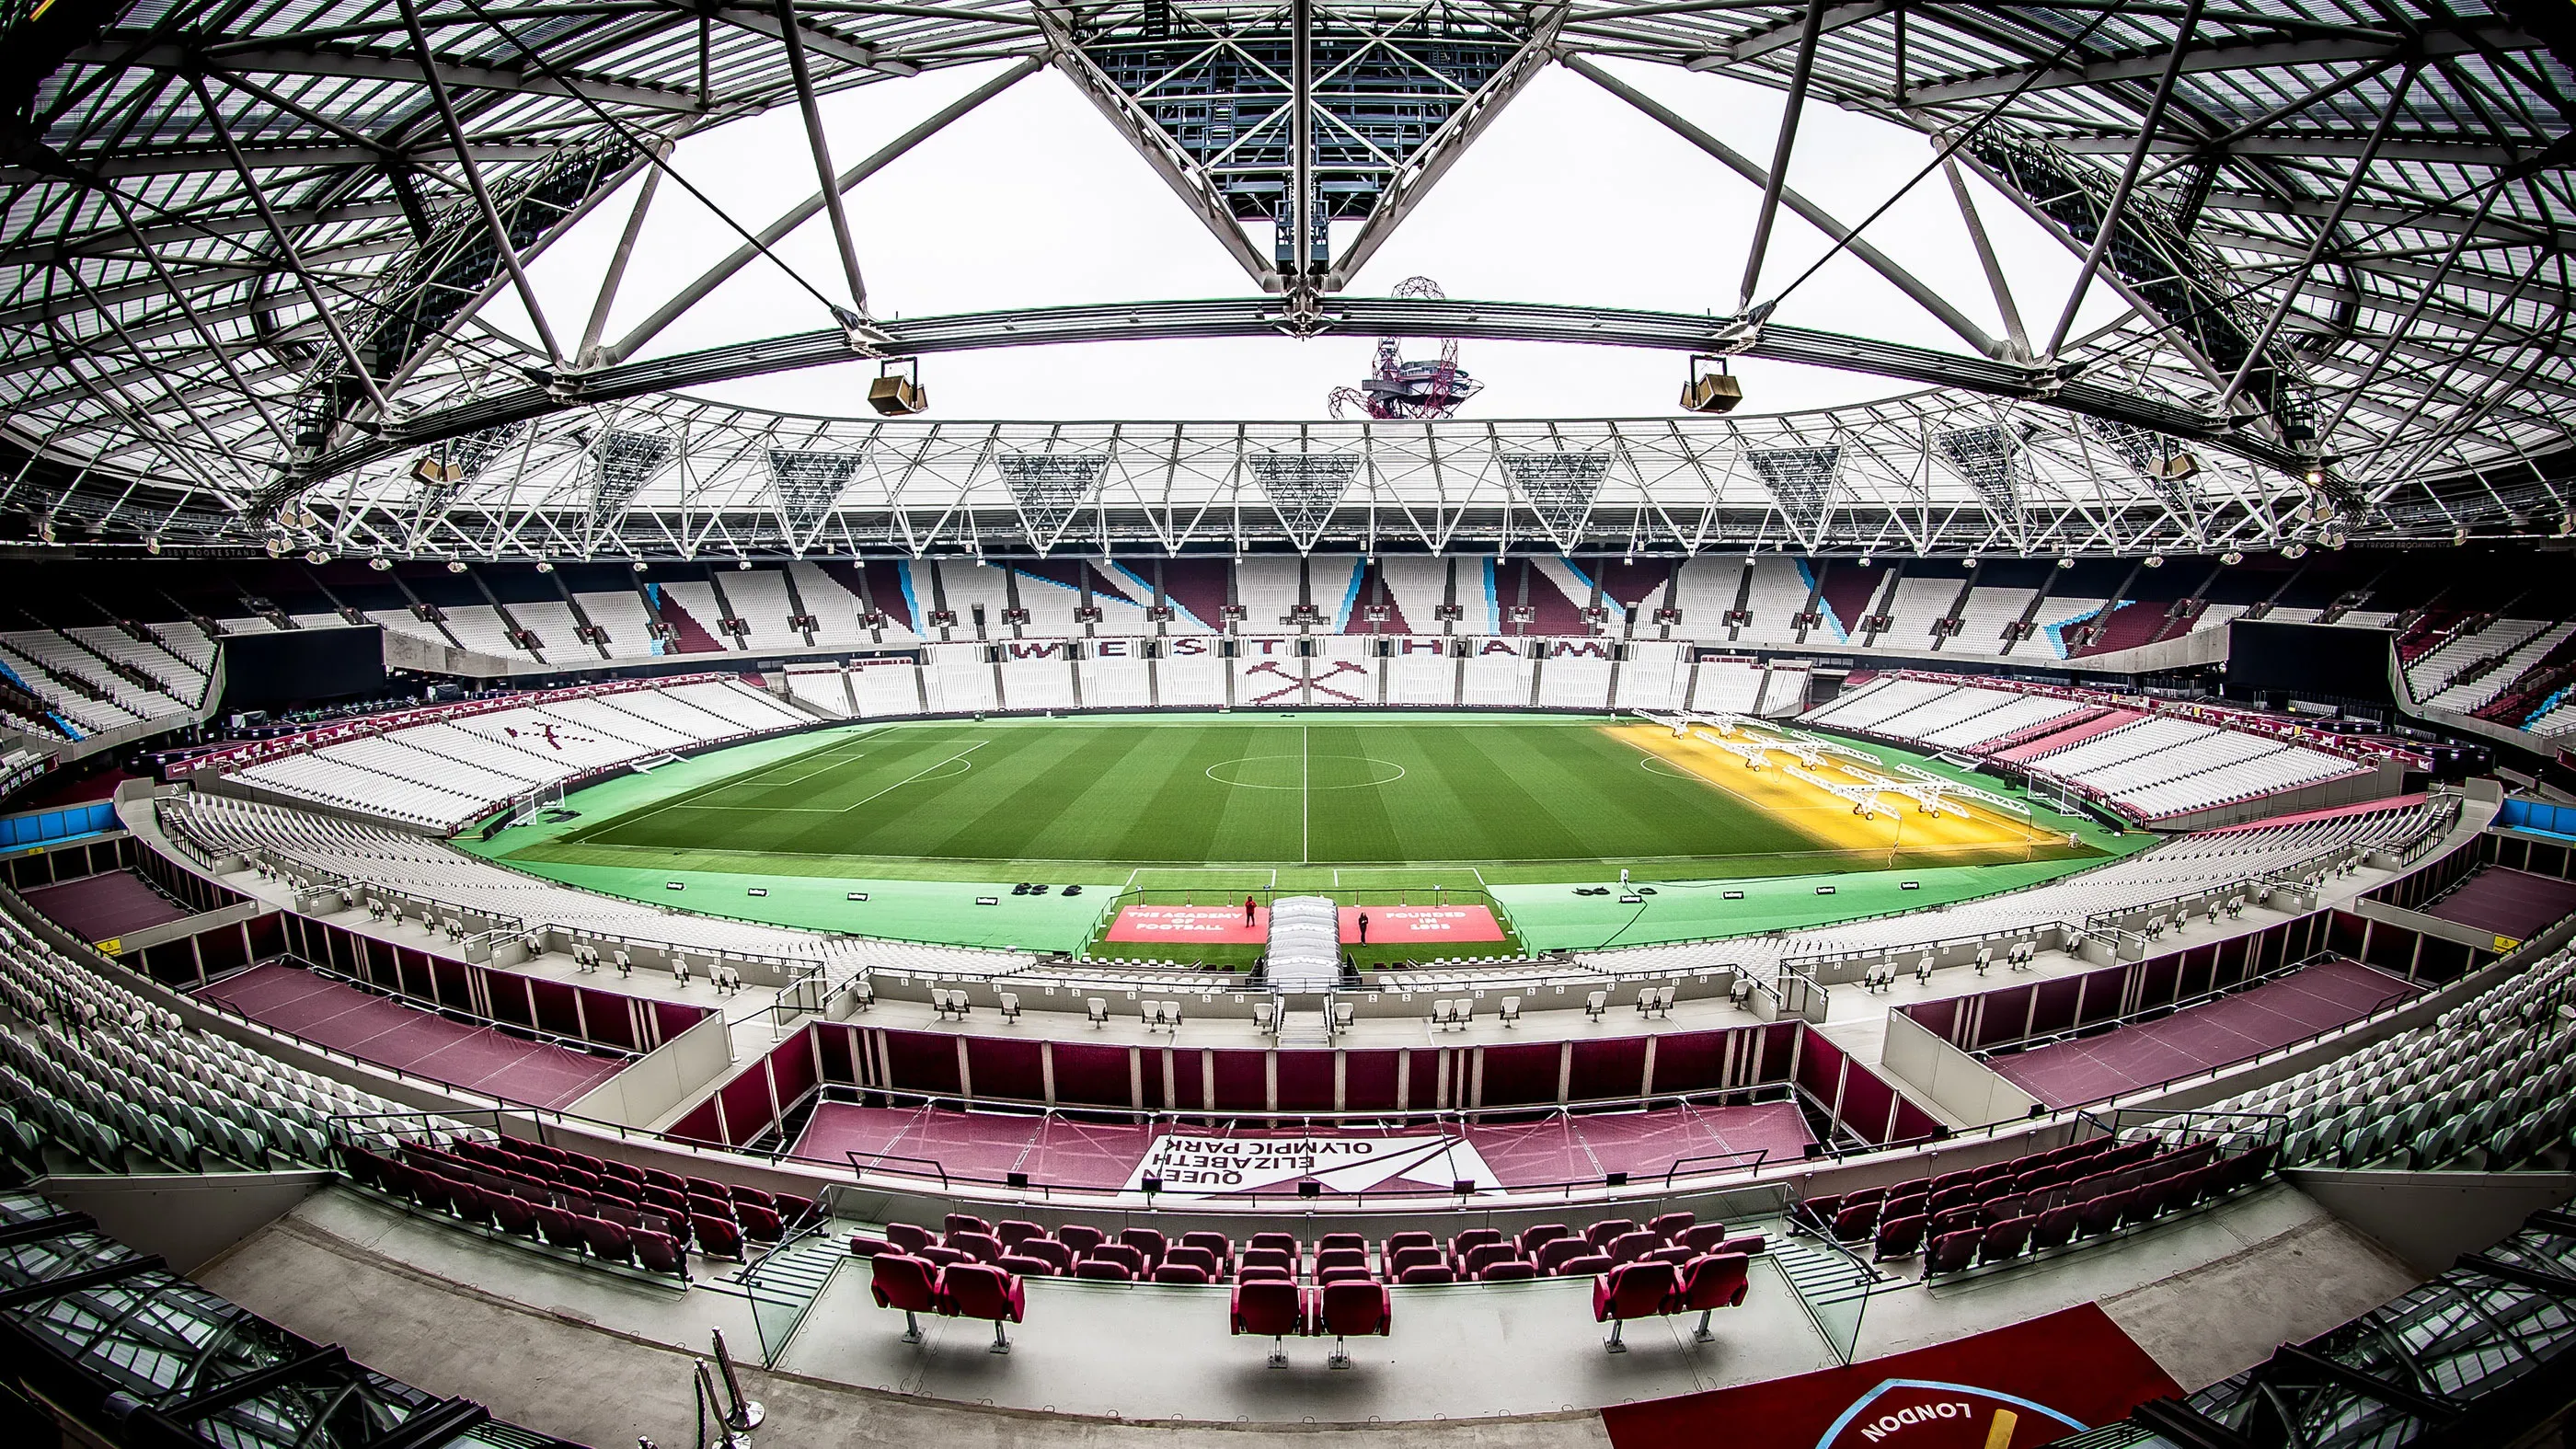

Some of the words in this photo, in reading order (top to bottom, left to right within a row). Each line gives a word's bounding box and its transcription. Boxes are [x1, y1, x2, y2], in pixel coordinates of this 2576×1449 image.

[2396, 541, 2437, 549] BROOKING
[1010, 638, 1285, 659] WEST
[1401, 638, 1606, 659] HAM
[1168, 1140, 1240, 1155] PARK
[1248, 1142, 1374, 1155] OLYMPIC
[1152, 1153, 1316, 1168] ELIZABETH
[1860, 1402, 1972, 1443] LONDON
